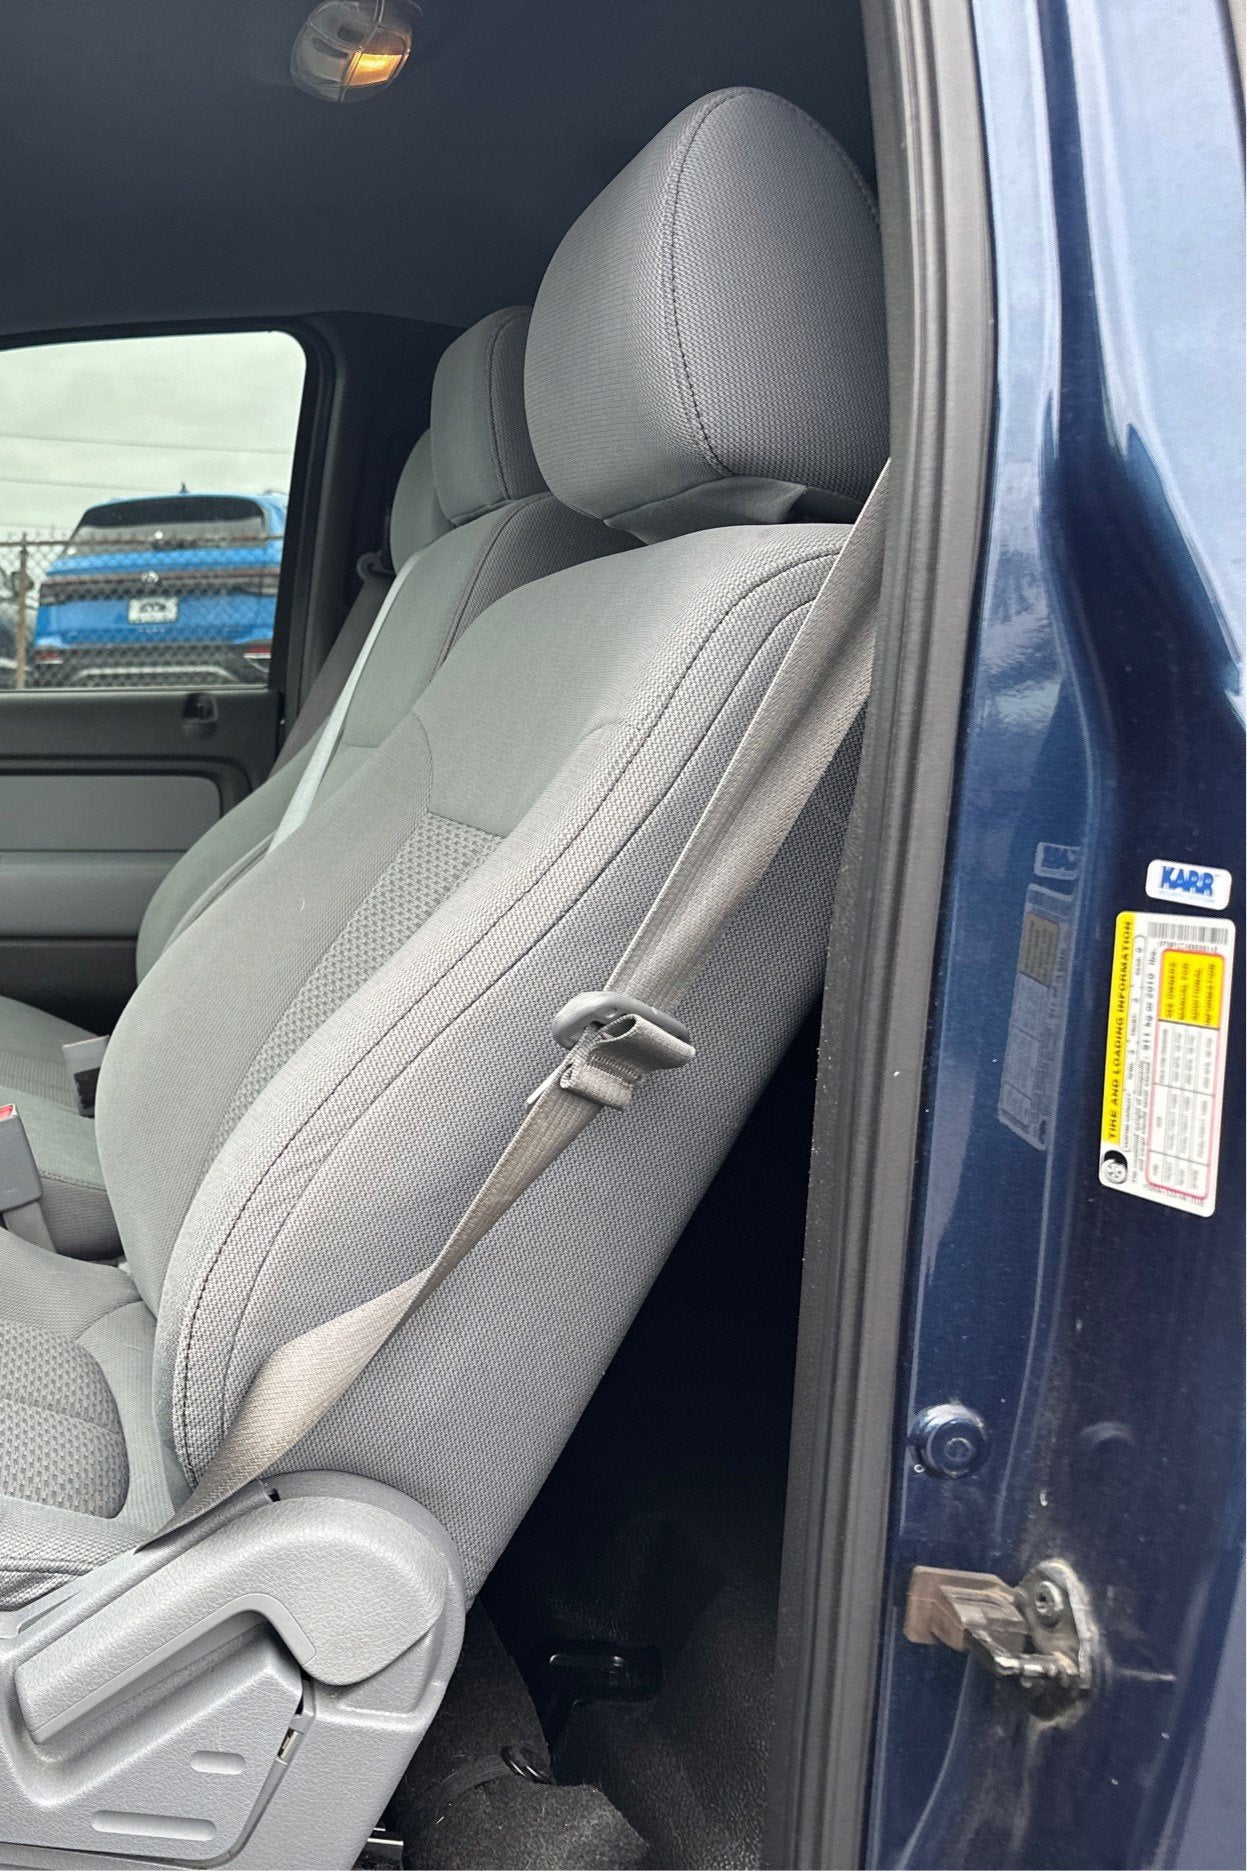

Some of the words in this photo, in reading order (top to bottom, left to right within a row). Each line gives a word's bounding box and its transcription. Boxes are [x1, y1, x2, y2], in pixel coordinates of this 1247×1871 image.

[1160, 866, 1214, 896] KARR
[1118, 920, 1132, 1012] INFORMATION
[1166, 1001, 1174, 1018] SEE
[1113, 1015, 1124, 1074] LOADING
[1143, 1031, 1151, 1051] 911
[1111, 1077, 1120, 1105] AND
[1109, 1108, 1118, 1139] TIRE
